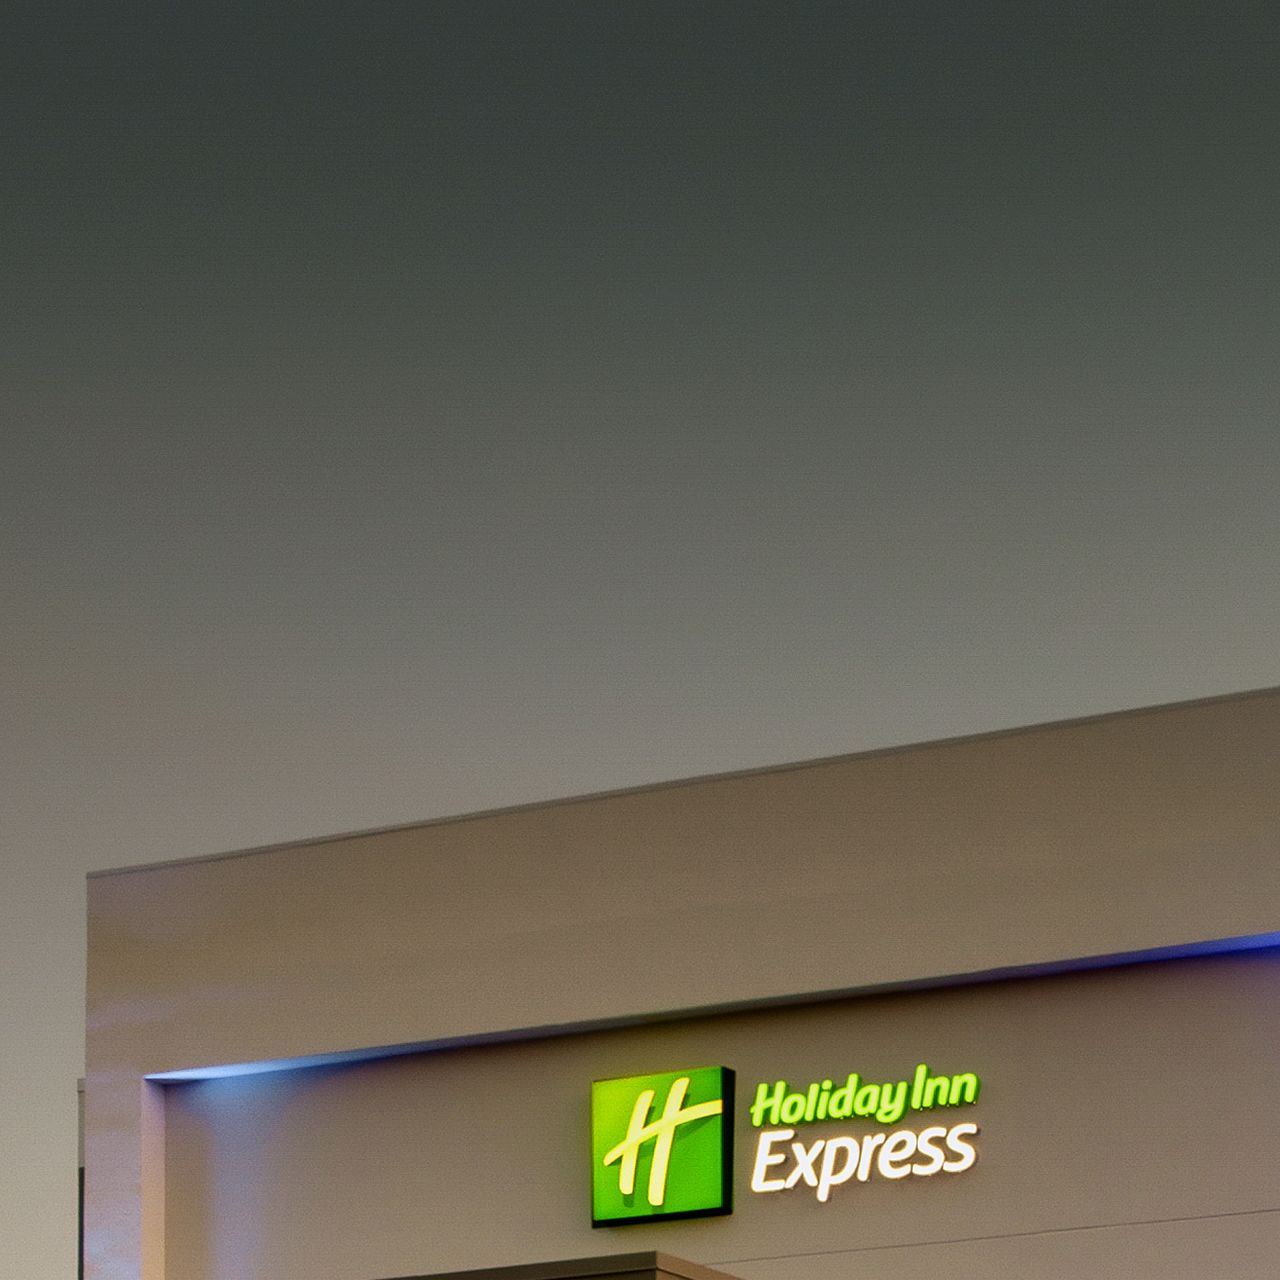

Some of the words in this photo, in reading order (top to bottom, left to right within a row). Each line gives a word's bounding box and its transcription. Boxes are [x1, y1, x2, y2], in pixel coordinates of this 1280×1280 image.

[750, 1073, 909, 1127] Holiday
[910, 1063, 980, 1110] Inn
[603, 1077, 723, 1206] H
[751, 1123, 978, 1203] Express
